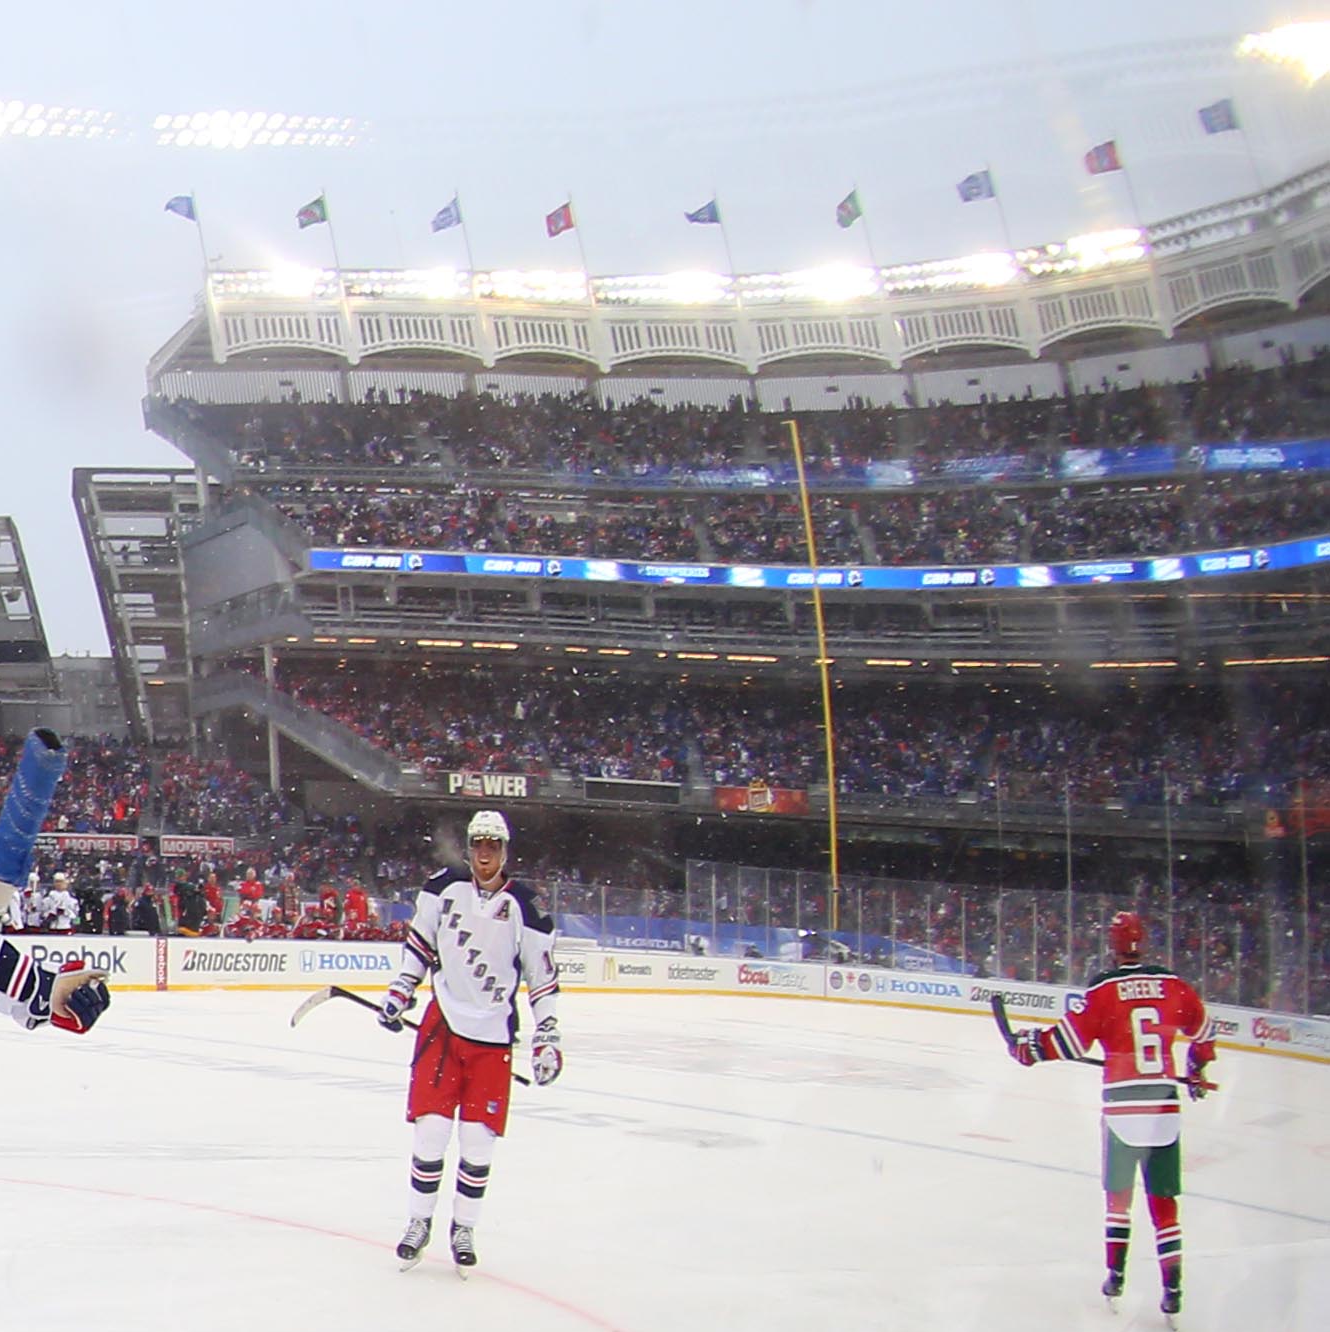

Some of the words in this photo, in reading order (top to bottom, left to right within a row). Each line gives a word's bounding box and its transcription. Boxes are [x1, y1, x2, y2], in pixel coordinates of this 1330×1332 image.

[492, 899, 510, 922] A
[181, 948, 288, 974] BRIDGESTONE
[317, 953, 393, 972] HONDA
[557, 960, 586, 977] prise
[738, 964, 770, 986] Coors
[890, 979, 962, 998] HONDA
[1116, 979, 1166, 1002] GREENE
[1130, 1006, 1166, 1075] 6
